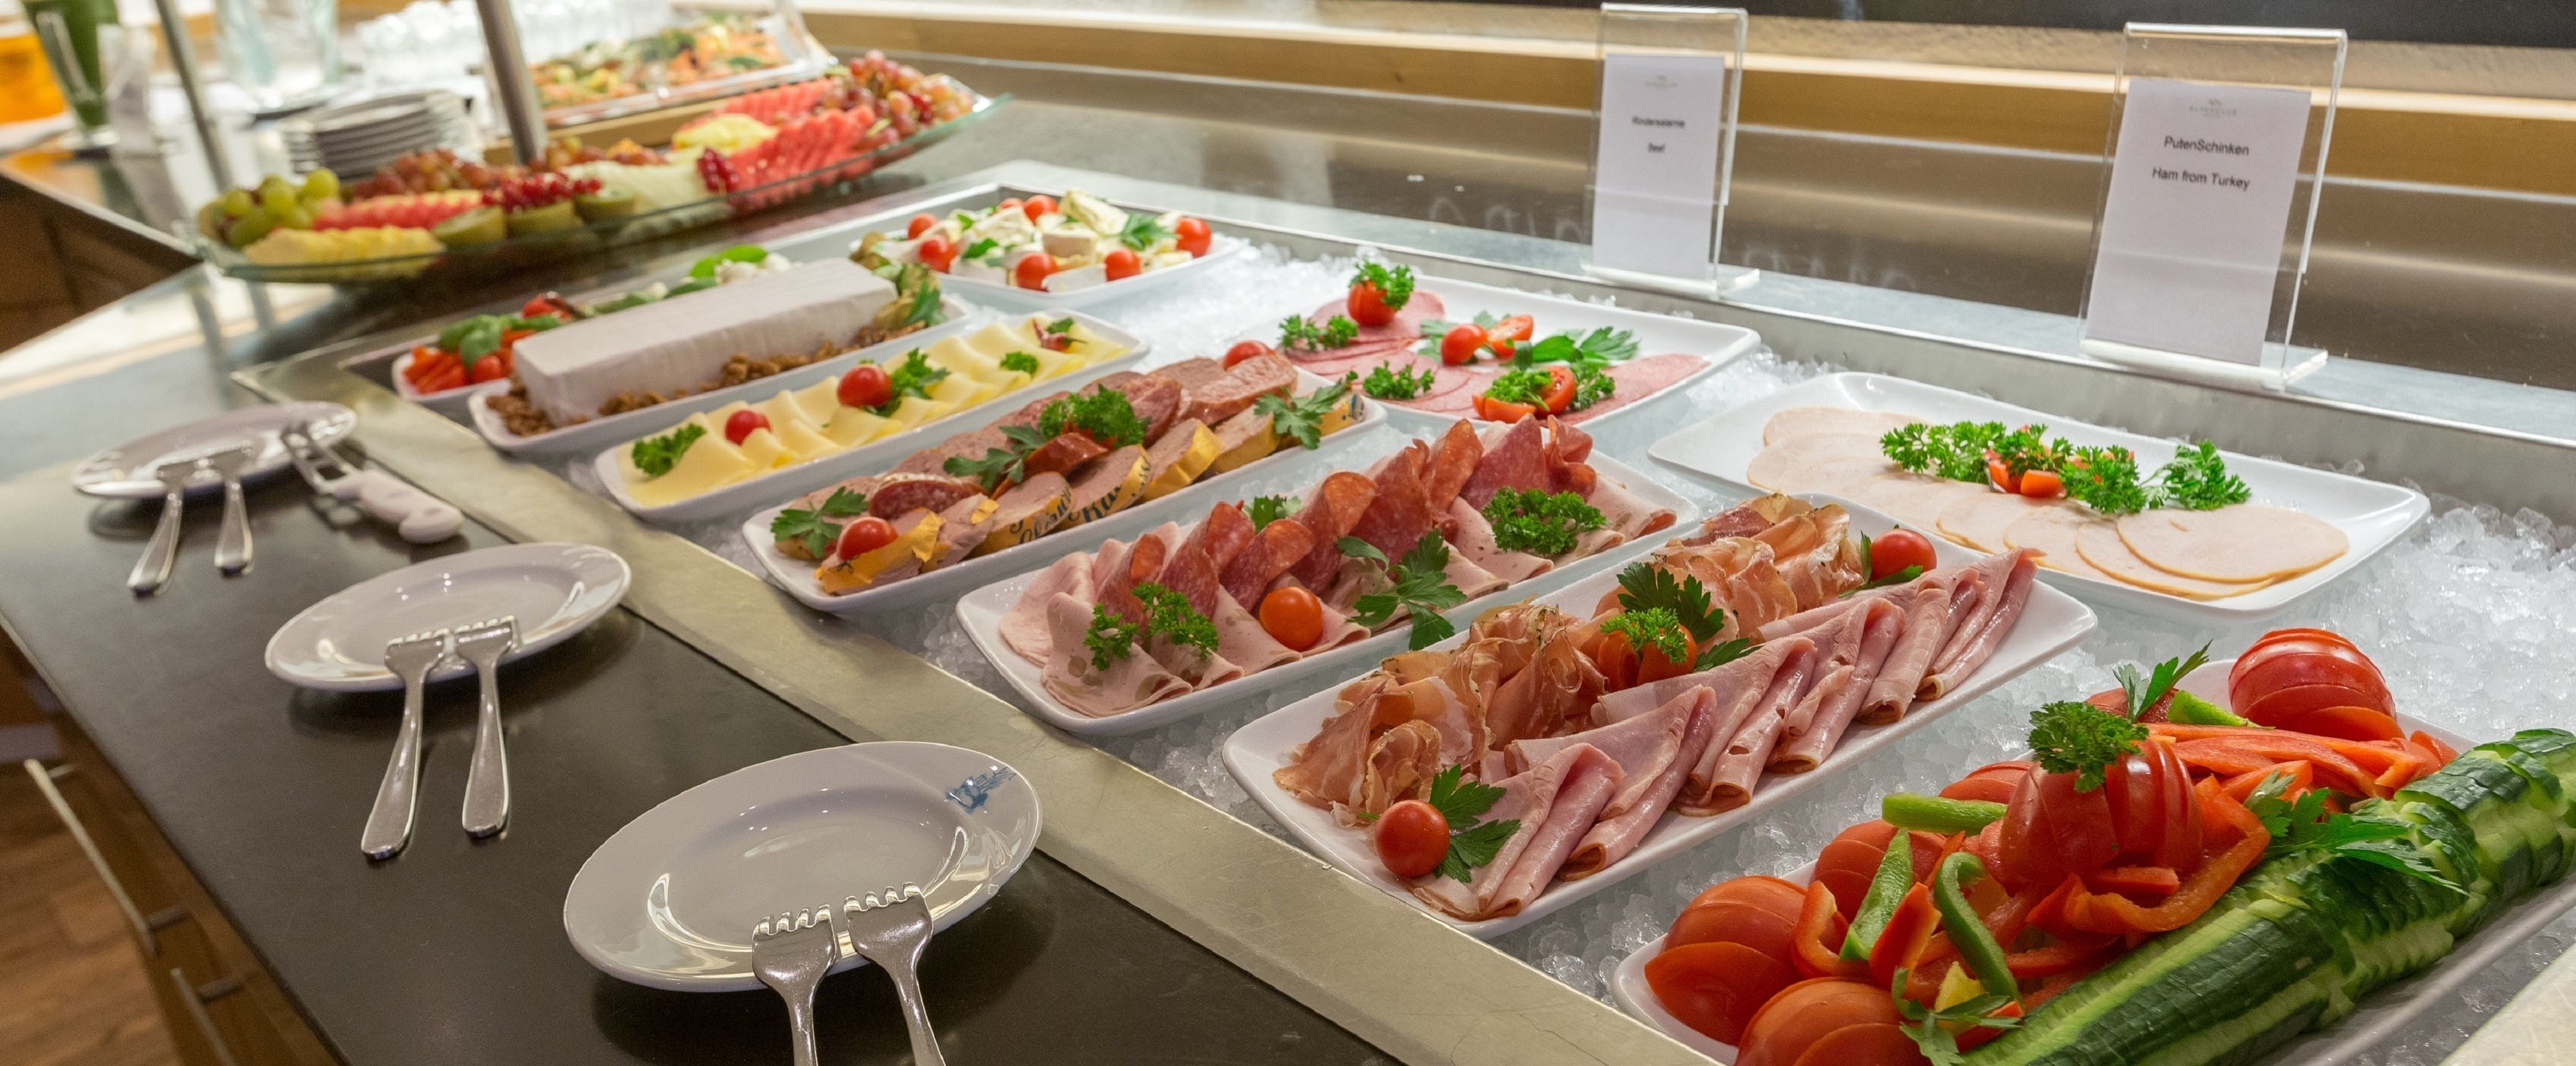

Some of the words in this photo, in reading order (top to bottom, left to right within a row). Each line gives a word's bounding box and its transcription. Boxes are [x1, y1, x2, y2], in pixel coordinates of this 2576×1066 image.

[2164, 135, 2249, 155] PutenSchinken
[2152, 167, 2178, 180] Ham
[2183, 169, 2207, 184] from
[2211, 172, 2250, 192] Turkey
